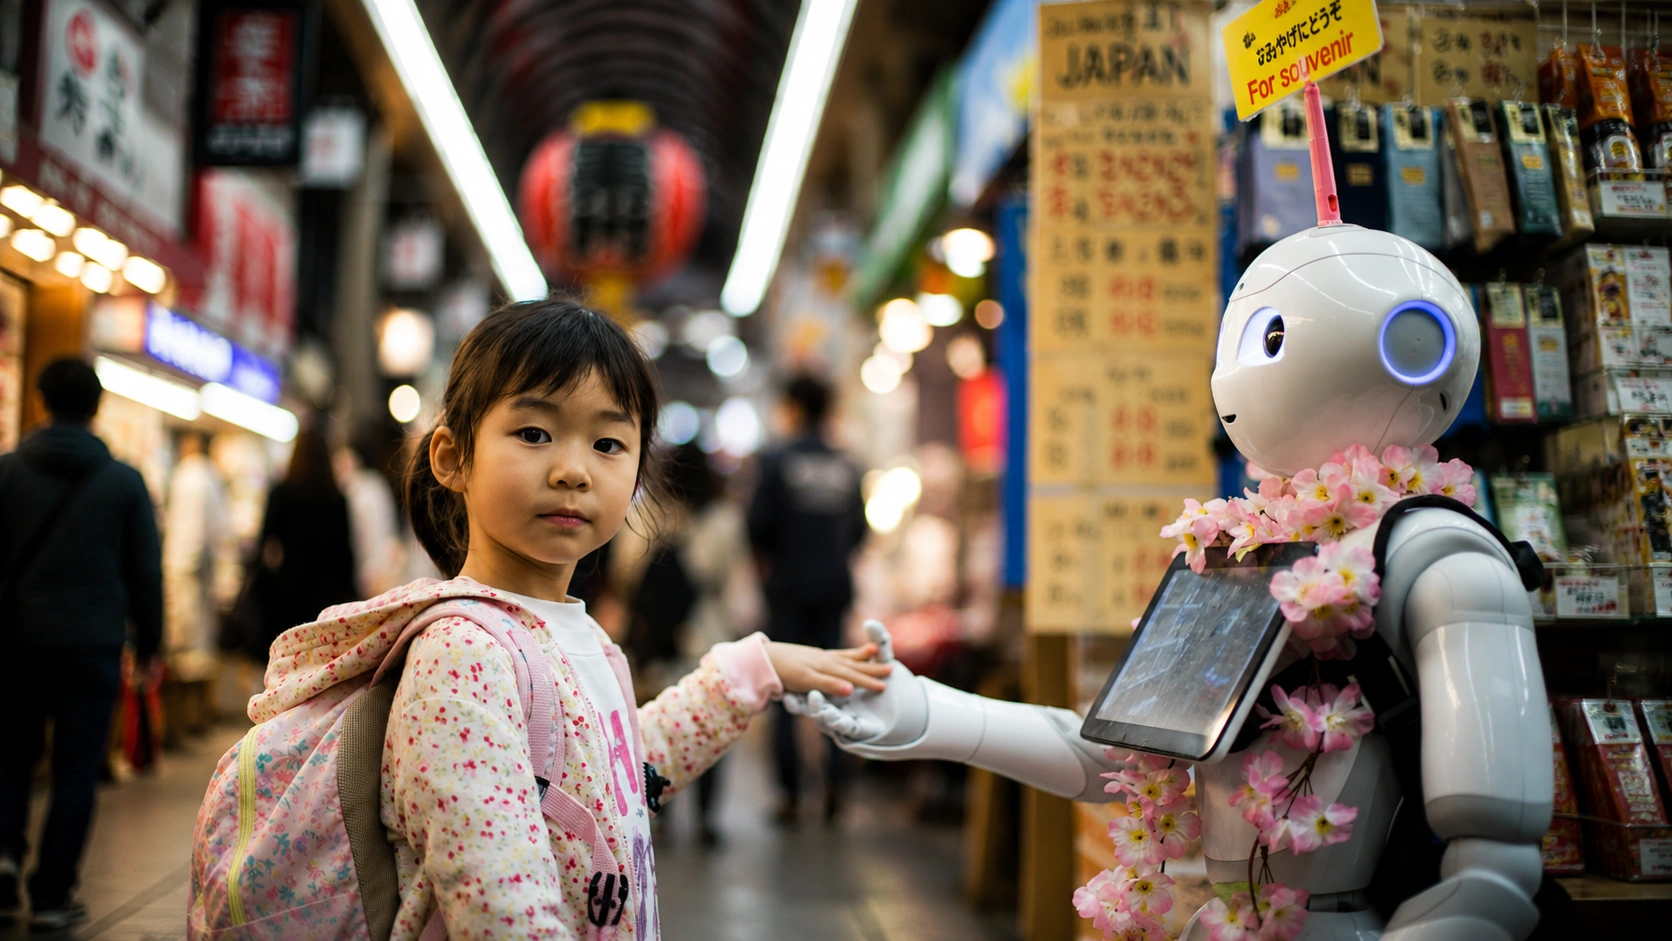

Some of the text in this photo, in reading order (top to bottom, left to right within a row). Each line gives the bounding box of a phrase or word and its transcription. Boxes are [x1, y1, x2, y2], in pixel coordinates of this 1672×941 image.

[1054, 41, 1191, 90] JAPAN
[1247, 74, 1275, 105] For
[1279, 30, 1354, 88] souvenir
